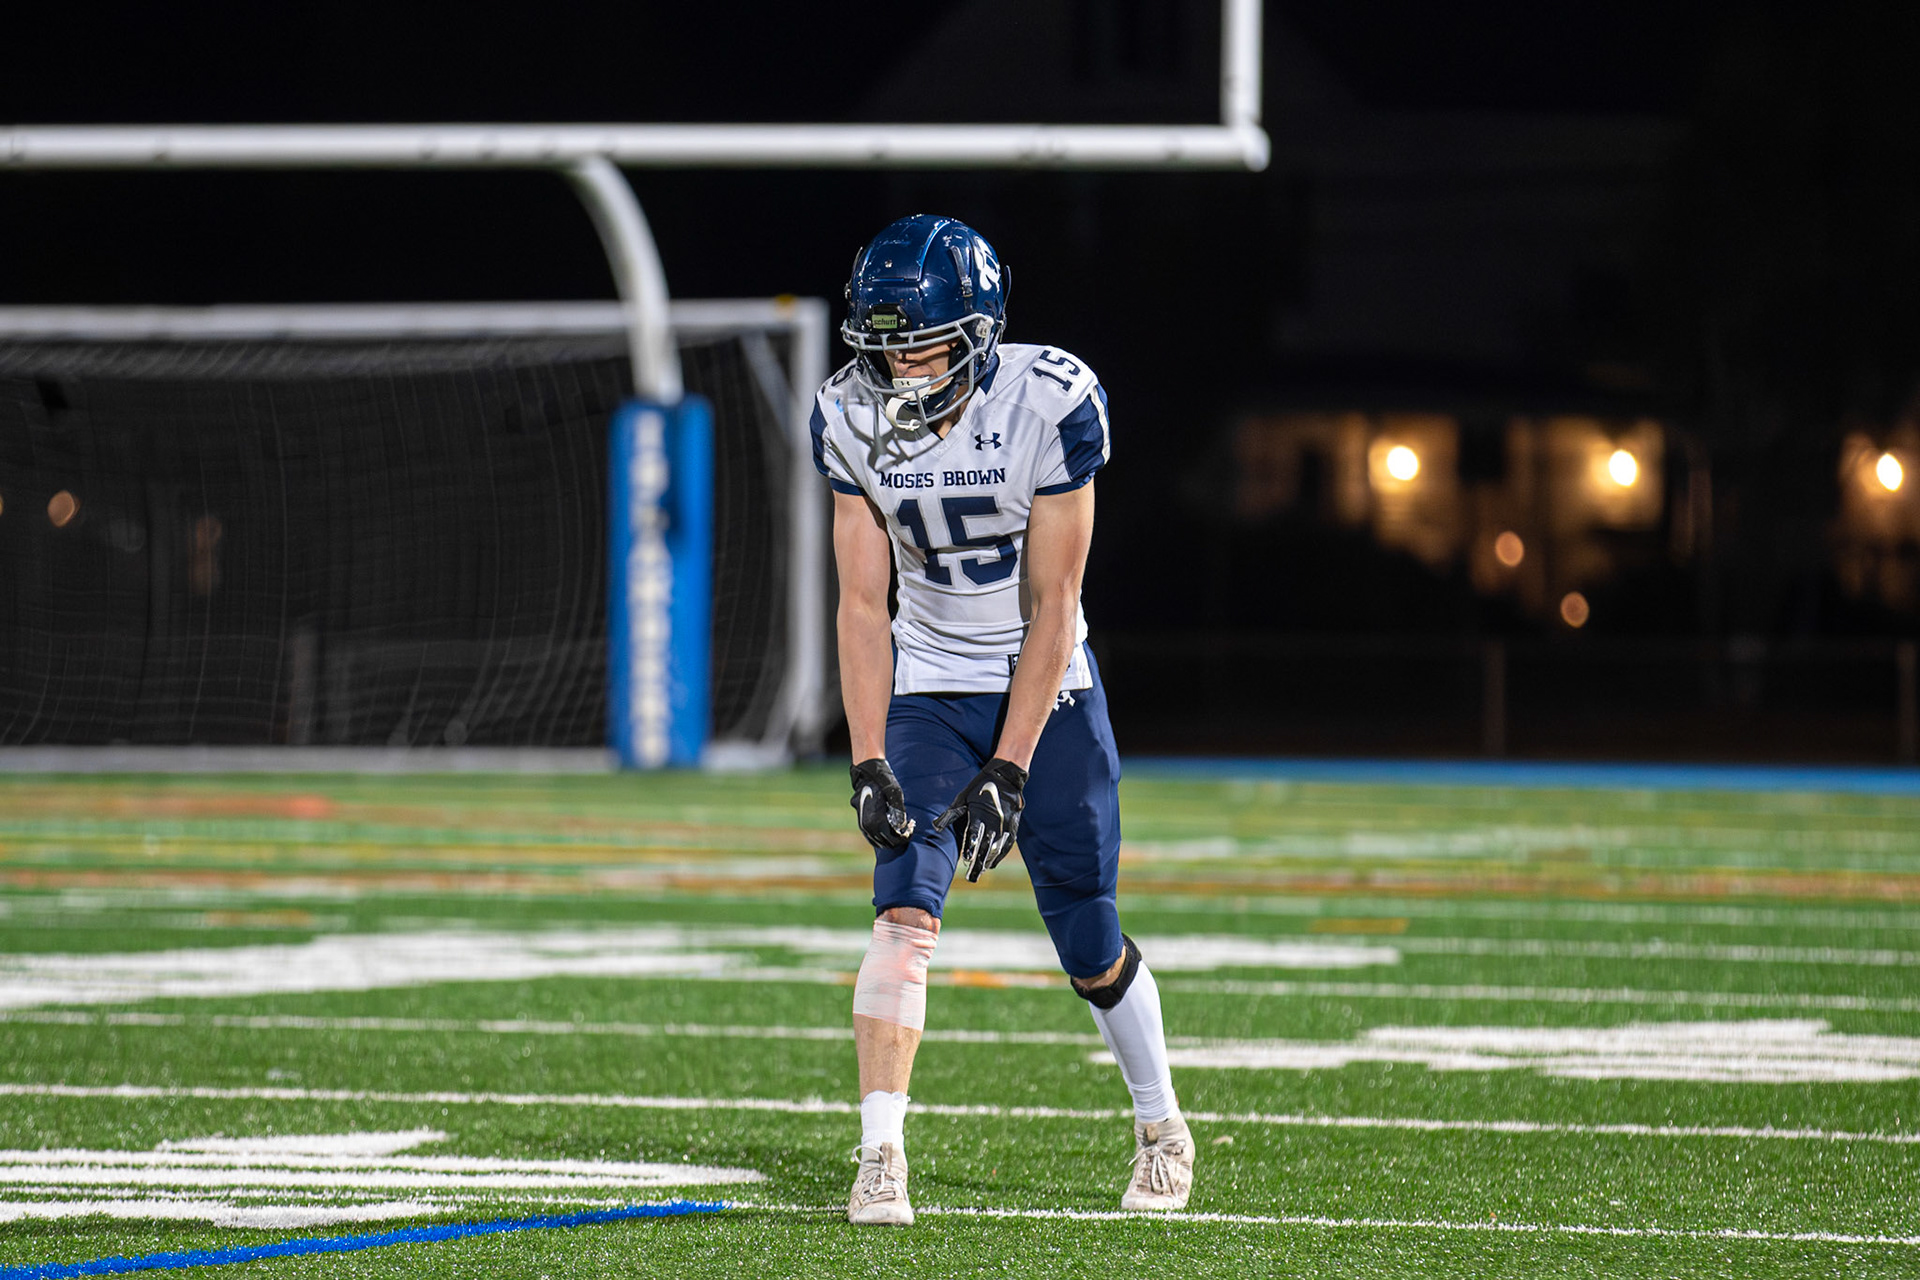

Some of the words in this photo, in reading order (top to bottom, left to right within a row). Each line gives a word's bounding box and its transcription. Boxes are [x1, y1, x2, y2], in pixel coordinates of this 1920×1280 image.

[1031, 349, 1081, 392] 15
[880, 471, 934, 489] MOSES
[943, 468, 1006, 487] BROWN
[895, 495, 1019, 587] 15
